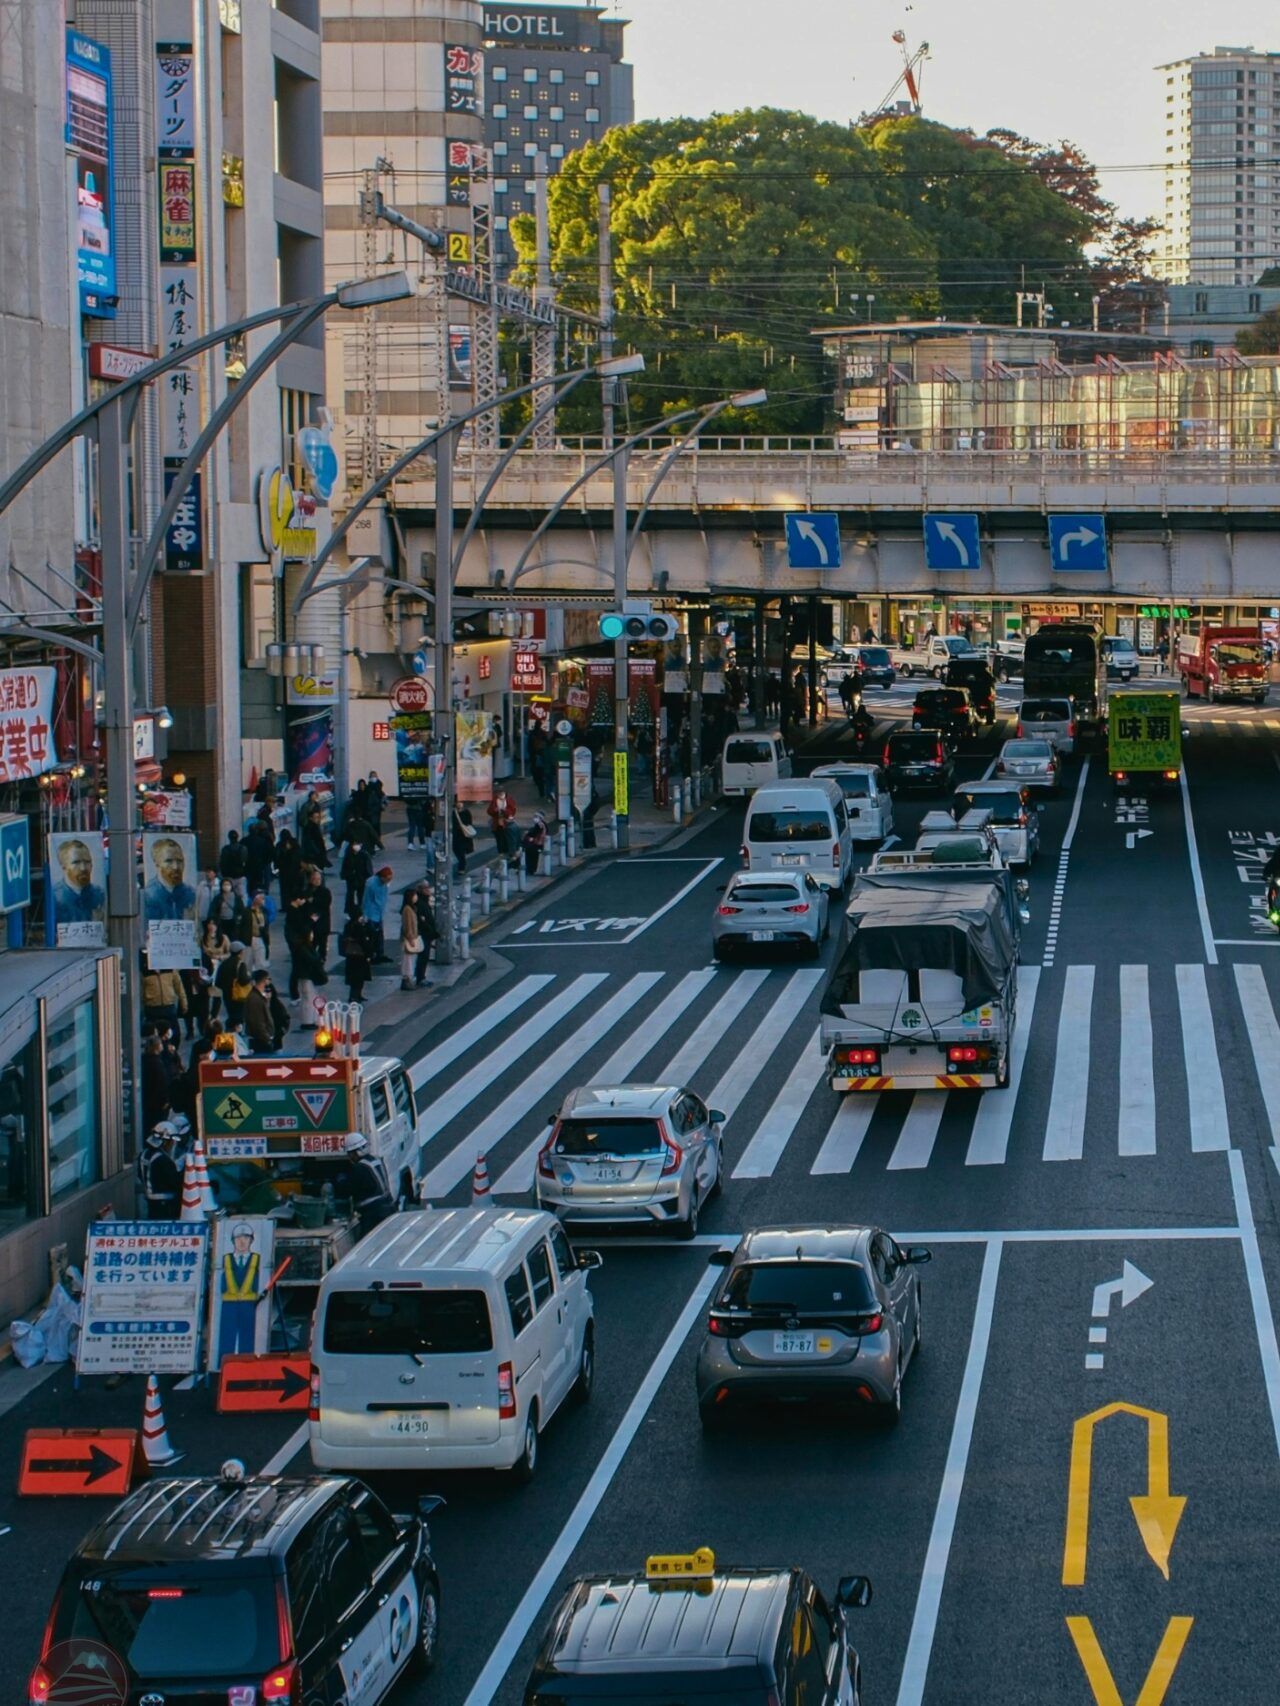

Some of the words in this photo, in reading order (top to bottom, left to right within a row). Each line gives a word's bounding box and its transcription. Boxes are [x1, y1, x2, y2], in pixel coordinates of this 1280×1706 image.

[485, 13, 564, 36] HOTEL
[165, 79, 188, 136] ダーツ
[165, 169, 191, 222] 麻雀
[516, 654, 534, 662] UNI
[516, 663, 535, 673] QLO
[0, 675, 38, 712] 常通り
[399, 690, 426, 704] 消火栓
[0, 716, 48, 779] 業中
[265, 1117, 297, 1128] 工事中
[95, 1224, 202, 1235] ご迷惑をおかけします
[94, 1251, 198, 1267] 道路の維持補修
[95, 1269, 194, 1283] を行っています
[782, 1340, 812, 1352] 87-87
[397, 1420, 429, 1432] 44-90
[80, 1580, 101, 1591] 148
